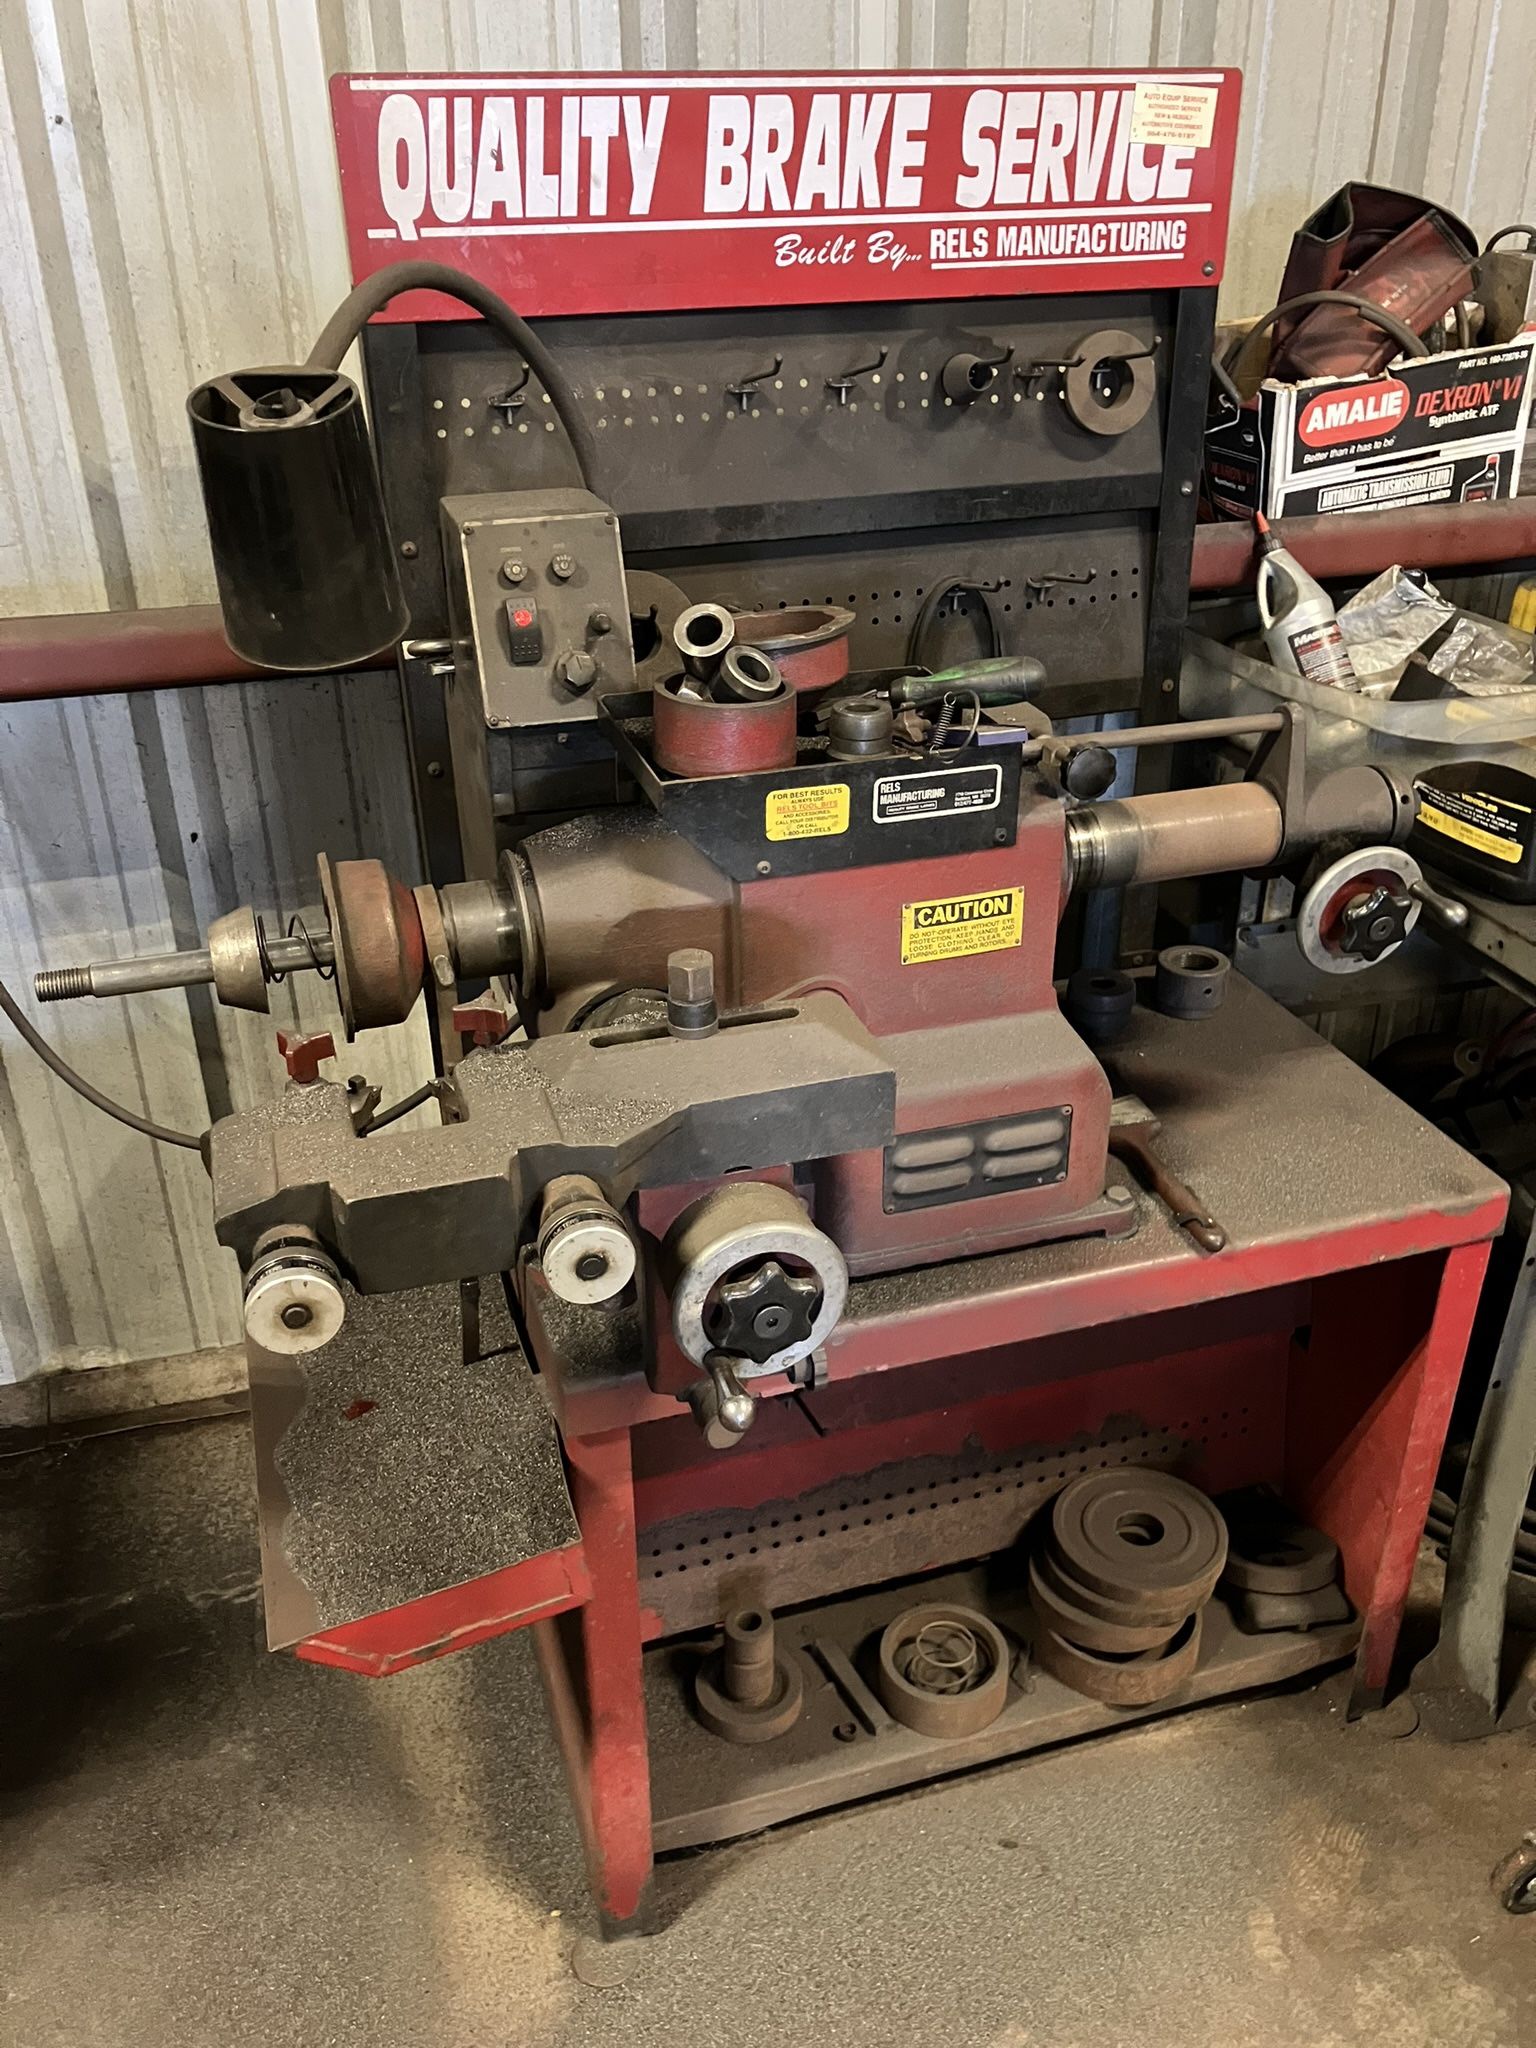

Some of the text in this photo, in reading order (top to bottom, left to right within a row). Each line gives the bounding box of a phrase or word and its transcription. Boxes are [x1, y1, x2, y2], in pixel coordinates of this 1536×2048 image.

[1144, 92, 1160, 100] AUTO
[1183, 95, 1208, 104] SERVICE
[378, 94, 670, 241] QUALITY
[703, 92, 932, 213] BRAKE
[773, 233, 857, 267] Built
[930, 225, 989, 260] RELS
[996, 219, 1187, 258] MANUFACTURING
[1458, 359, 1477, 370] PART
[1503, 375, 1524, 401] VI
[1305, 390, 1404, 434] AMALIE
[1428, 403, 1500, 428] Synthetic ATF
[1303, 451, 1329, 464] Better
[1329, 448, 1349, 458] than
[1349, 445, 1356, 454] it
[1356, 443, 1373, 452] has
[1373, 440, 1383, 450] to
[1322, 484, 1369, 508] AUTOMATIC
[1368, 472, 1428, 500] TRANSMISSION
[1428, 467, 1451, 488] FLUID
[790, 790, 809, 798] BEST
[810, 788, 843, 796] RESULTS
[880, 782, 901, 794] RELS
[880, 788, 946, 805] MANUFACTURING
[776, 800, 838, 813] RELS TOOL BITS
[917, 895, 1008, 927] CAUTION
[910, 932, 919, 940] DO
[922, 930, 937, 938] NOT
[938, 926, 968, 936] OPERATE
[971, 920, 1000, 930] WITHOUT
[956, 932, 973, 940] KEEP
[976, 928, 998, 936] HANDS
[1002, 924, 1015, 932] AND
[909, 943, 933, 953] LOOSE
[938, 938, 974, 949] CLOTHING
[978, 934, 1001, 942] CLEAR
[909, 950, 938, 960] TURNING
[940, 946, 963, 955] DRUMS
